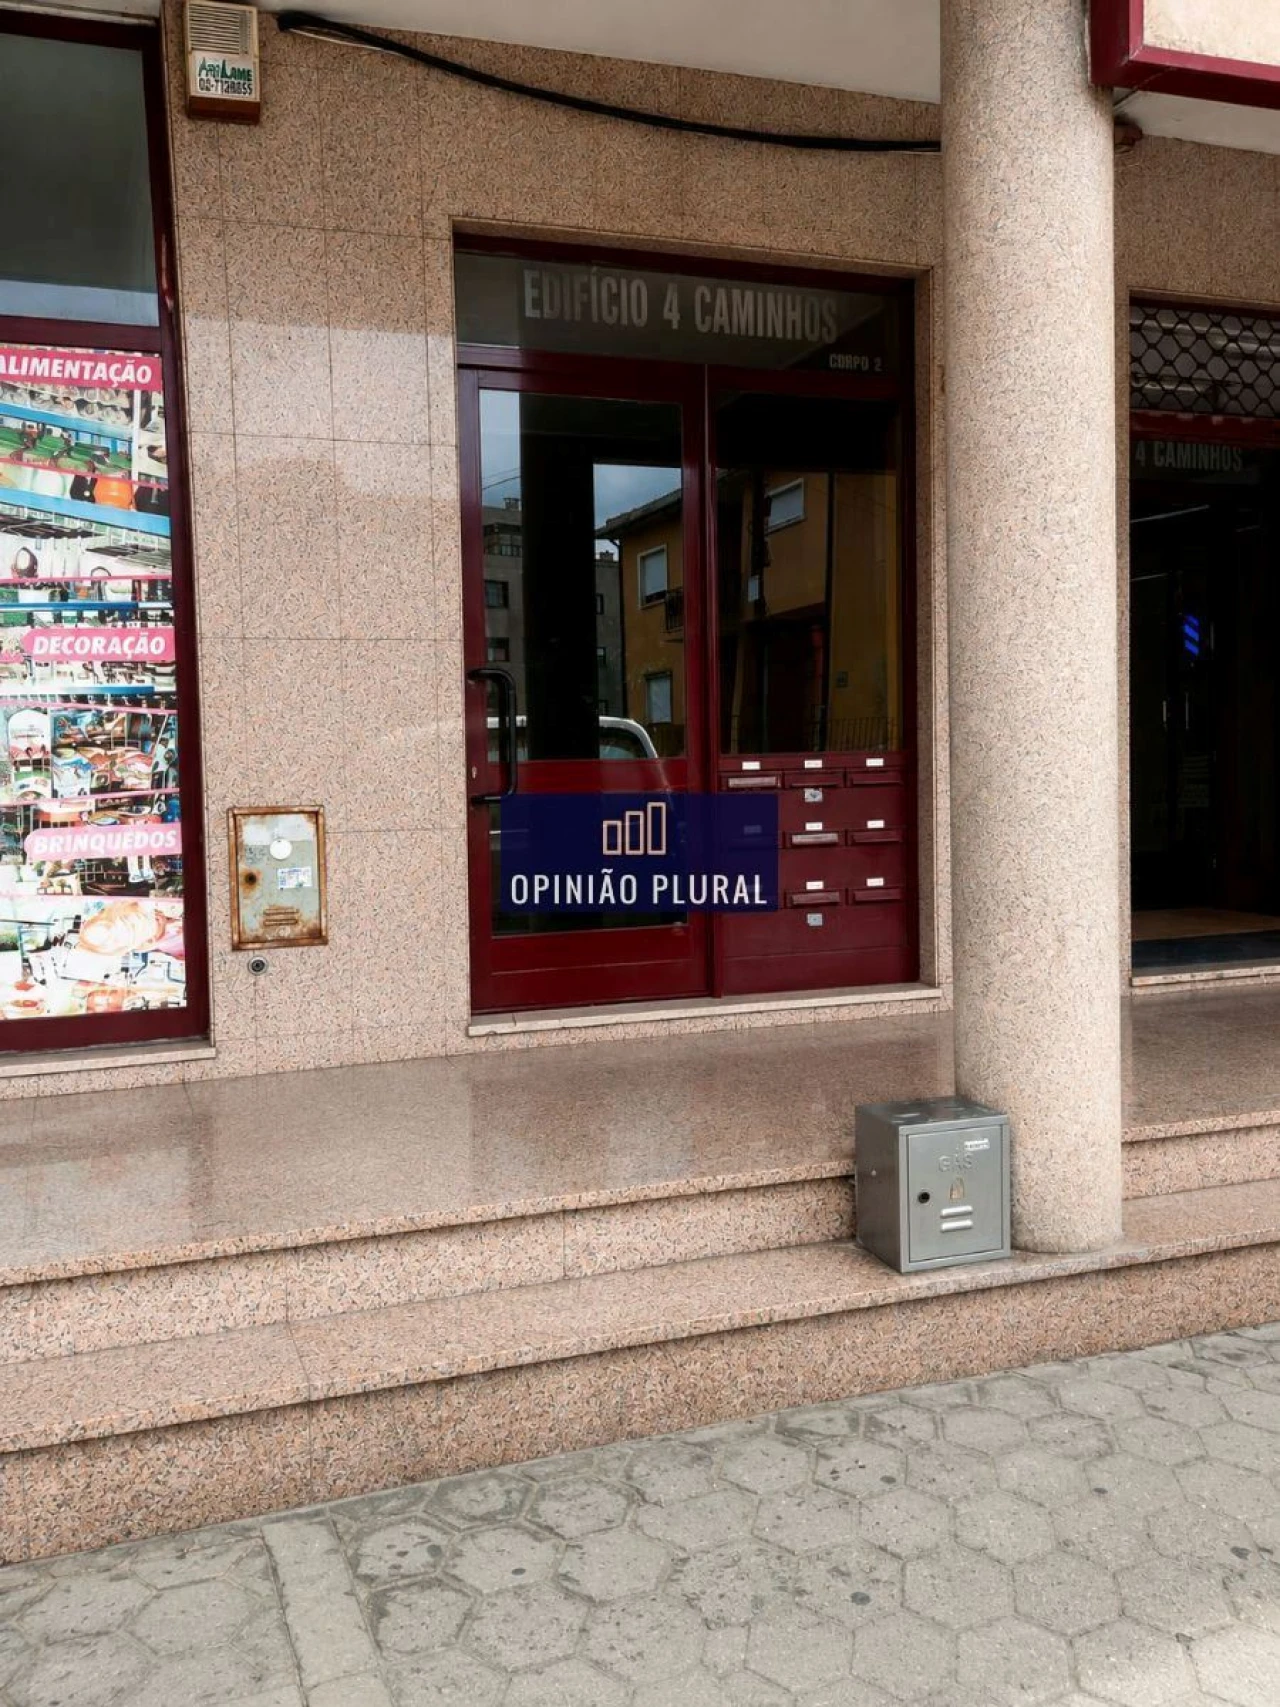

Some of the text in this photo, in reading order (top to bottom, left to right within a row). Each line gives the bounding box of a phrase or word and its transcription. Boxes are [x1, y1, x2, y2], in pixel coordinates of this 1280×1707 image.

[523, 267, 839, 343] EDIFÍCIO 4 CAMINHOS
[829, 353, 882, 372] CORPO 2
[1135, 441, 1243, 472] 4 CAMINHOS
[33, 632, 166, 659] DECORAÇÃO
[33, 830, 177, 855] BRINQUEDOS
